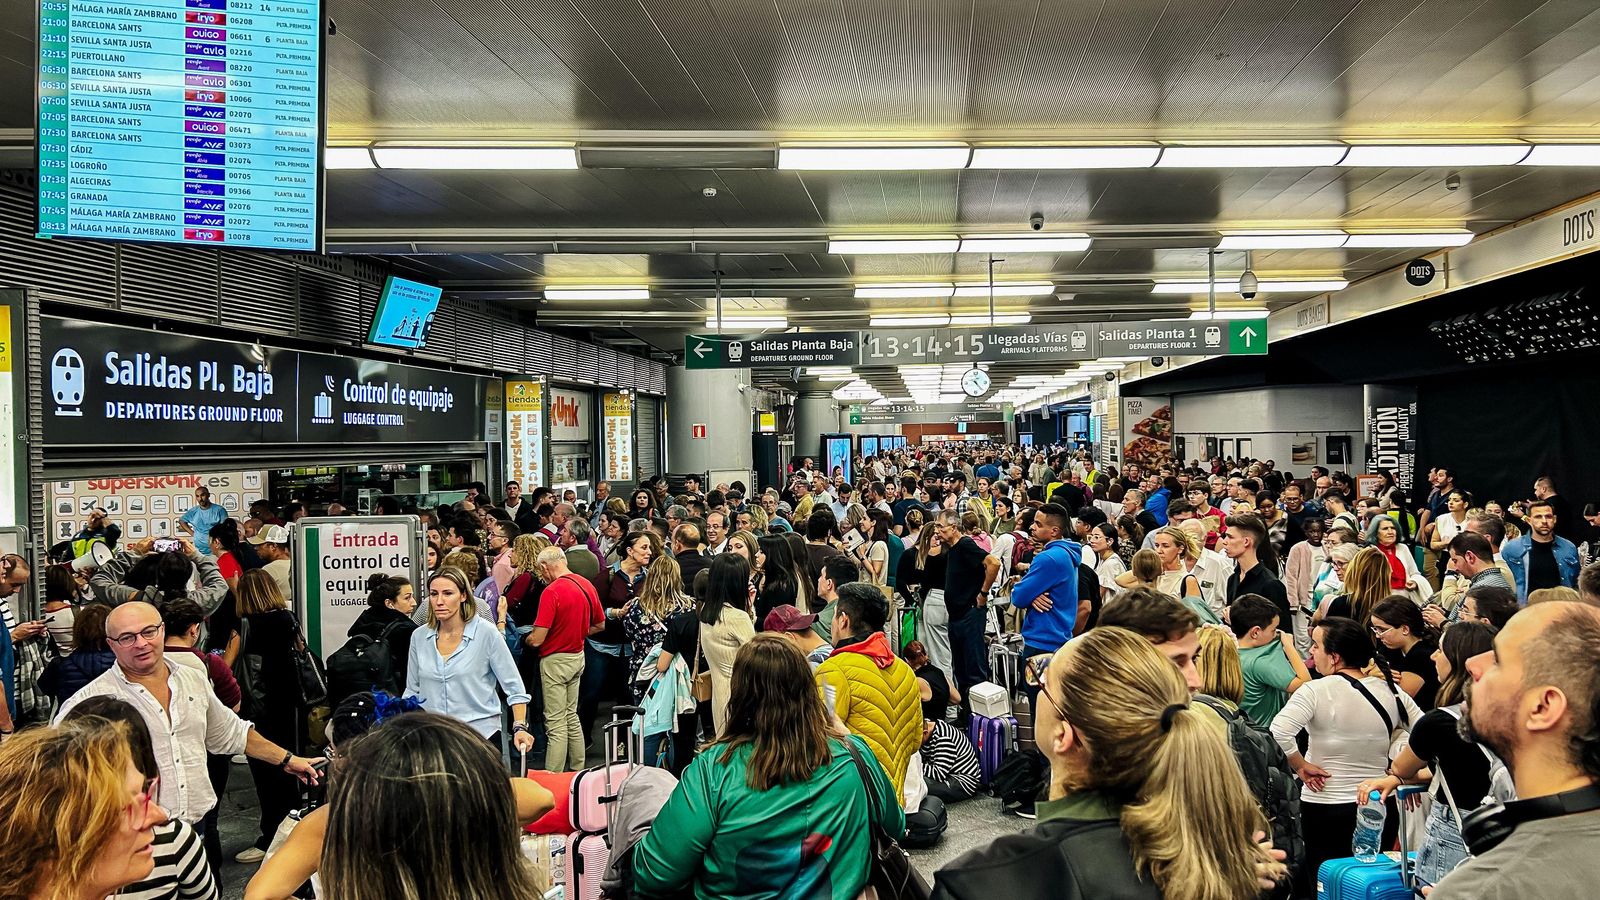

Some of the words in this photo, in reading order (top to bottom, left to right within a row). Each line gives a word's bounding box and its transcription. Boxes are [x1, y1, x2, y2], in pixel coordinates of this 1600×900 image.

[42, 1, 66, 10] 20:55
[72, 4, 103, 13] MÁLAGA
[106, 6, 131, 15] MARÍA
[134, 9, 177, 19] ZAMBRANO
[197, 13, 214, 23] iryo
[42, 17, 66, 26] 21:00
[71, 20, 115, 30] BARCELONA
[118, 23, 141, 32] SANTS
[42, 33, 66, 42] 21:10
[71, 35, 100, 44] SEVILLA
[103, 38, 127, 46] SANTA
[129, 40, 152, 48] JUSTA
[203, 46, 224, 55] avlo
[42, 49, 66, 58] 22:15
[71, 51, 124, 62] PUERTOLLANO
[42, 65, 66, 74] 06:30
[71, 67, 115, 77] BARCELONA
[117, 70, 141, 79] SANTS
[203, 77, 224, 86] avlo
[41, 80, 66, 89] 06:30
[70, 83, 100, 92] SEVILLA
[129, 87, 151, 95] JUSTA
[196, 91, 214, 100] iryo
[41, 96, 65, 105] 07:00
[70, 98, 100, 107] SEVILLA
[102, 100, 126, 109] SANTA
[129, 102, 151, 111] JUSTA
[202, 110, 224, 118] AVE
[41, 112, 65, 121] 07:05
[71, 114, 115, 124] BARCELONA
[117, 117, 141, 126] SANTS
[41, 128, 65, 136] 07:30
[71, 130, 115, 140] BARCELONA
[118, 134, 141, 142] SANTS
[41, 143, 65, 152] 07:30
[70, 144, 92, 154] CÁDIZ
[41, 159, 65, 168] 07:35
[70, 161, 107, 170] LOGROÑO
[41, 174, 65, 183] 07:38
[70, 176, 111, 186] ALGECIRAS
[40, 190, 65, 199] 07:45
[70, 192, 108, 201] GRANADA
[40, 206, 65, 214] 07:45
[70, 207, 102, 216] MÁLAGA
[105, 210, 130, 218] MARÍA
[132, 212, 175, 221] ZAMBRANO
[40, 221, 65, 230] 08:13
[70, 222, 102, 232] MÁLAGA
[105, 225, 130, 233] MARÍA
[132, 227, 175, 236] ZAMBRANO
[195, 229, 212, 238] iryo
[1564, 210, 1594, 246] DOTS
[1411, 266, 1430, 276] DOTS
[988, 333, 1040, 346] Llegadas
[1044, 332, 1067, 343] Vías
[1099, 330, 1142, 340] Salidas
[1146, 328, 1184, 339] Planta
[1189, 328, 1197, 338] 1
[750, 341, 788, 351] Salidas
[792, 340, 826, 350] Planta
[830, 339, 853, 351] Baja
[105, 352, 192, 390] Salidas
[199, 361, 225, 392] Pl.
[233, 364, 273, 400] Baja
[344, 379, 388, 403] Control
[392, 382, 406, 405] de
[409, 385, 453, 412] equipaje
[508, 395, 540, 403] tiendas
[106, 402, 195, 421] DEPARTURES
[199, 406, 248, 422] GROUND
[251, 408, 283, 422] FLOOR
[344, 412, 374, 424] LUGGAGE
[377, 414, 404, 425] CONTROL
[1399, 407, 1409, 440] QUALITY
[1399, 453, 1409, 489] PREMIUM
[334, 532, 398, 547] Entrada
[322, 554, 382, 569] Control
[390, 554, 410, 568] de
[331, 598, 368, 606] LUGGAGE
